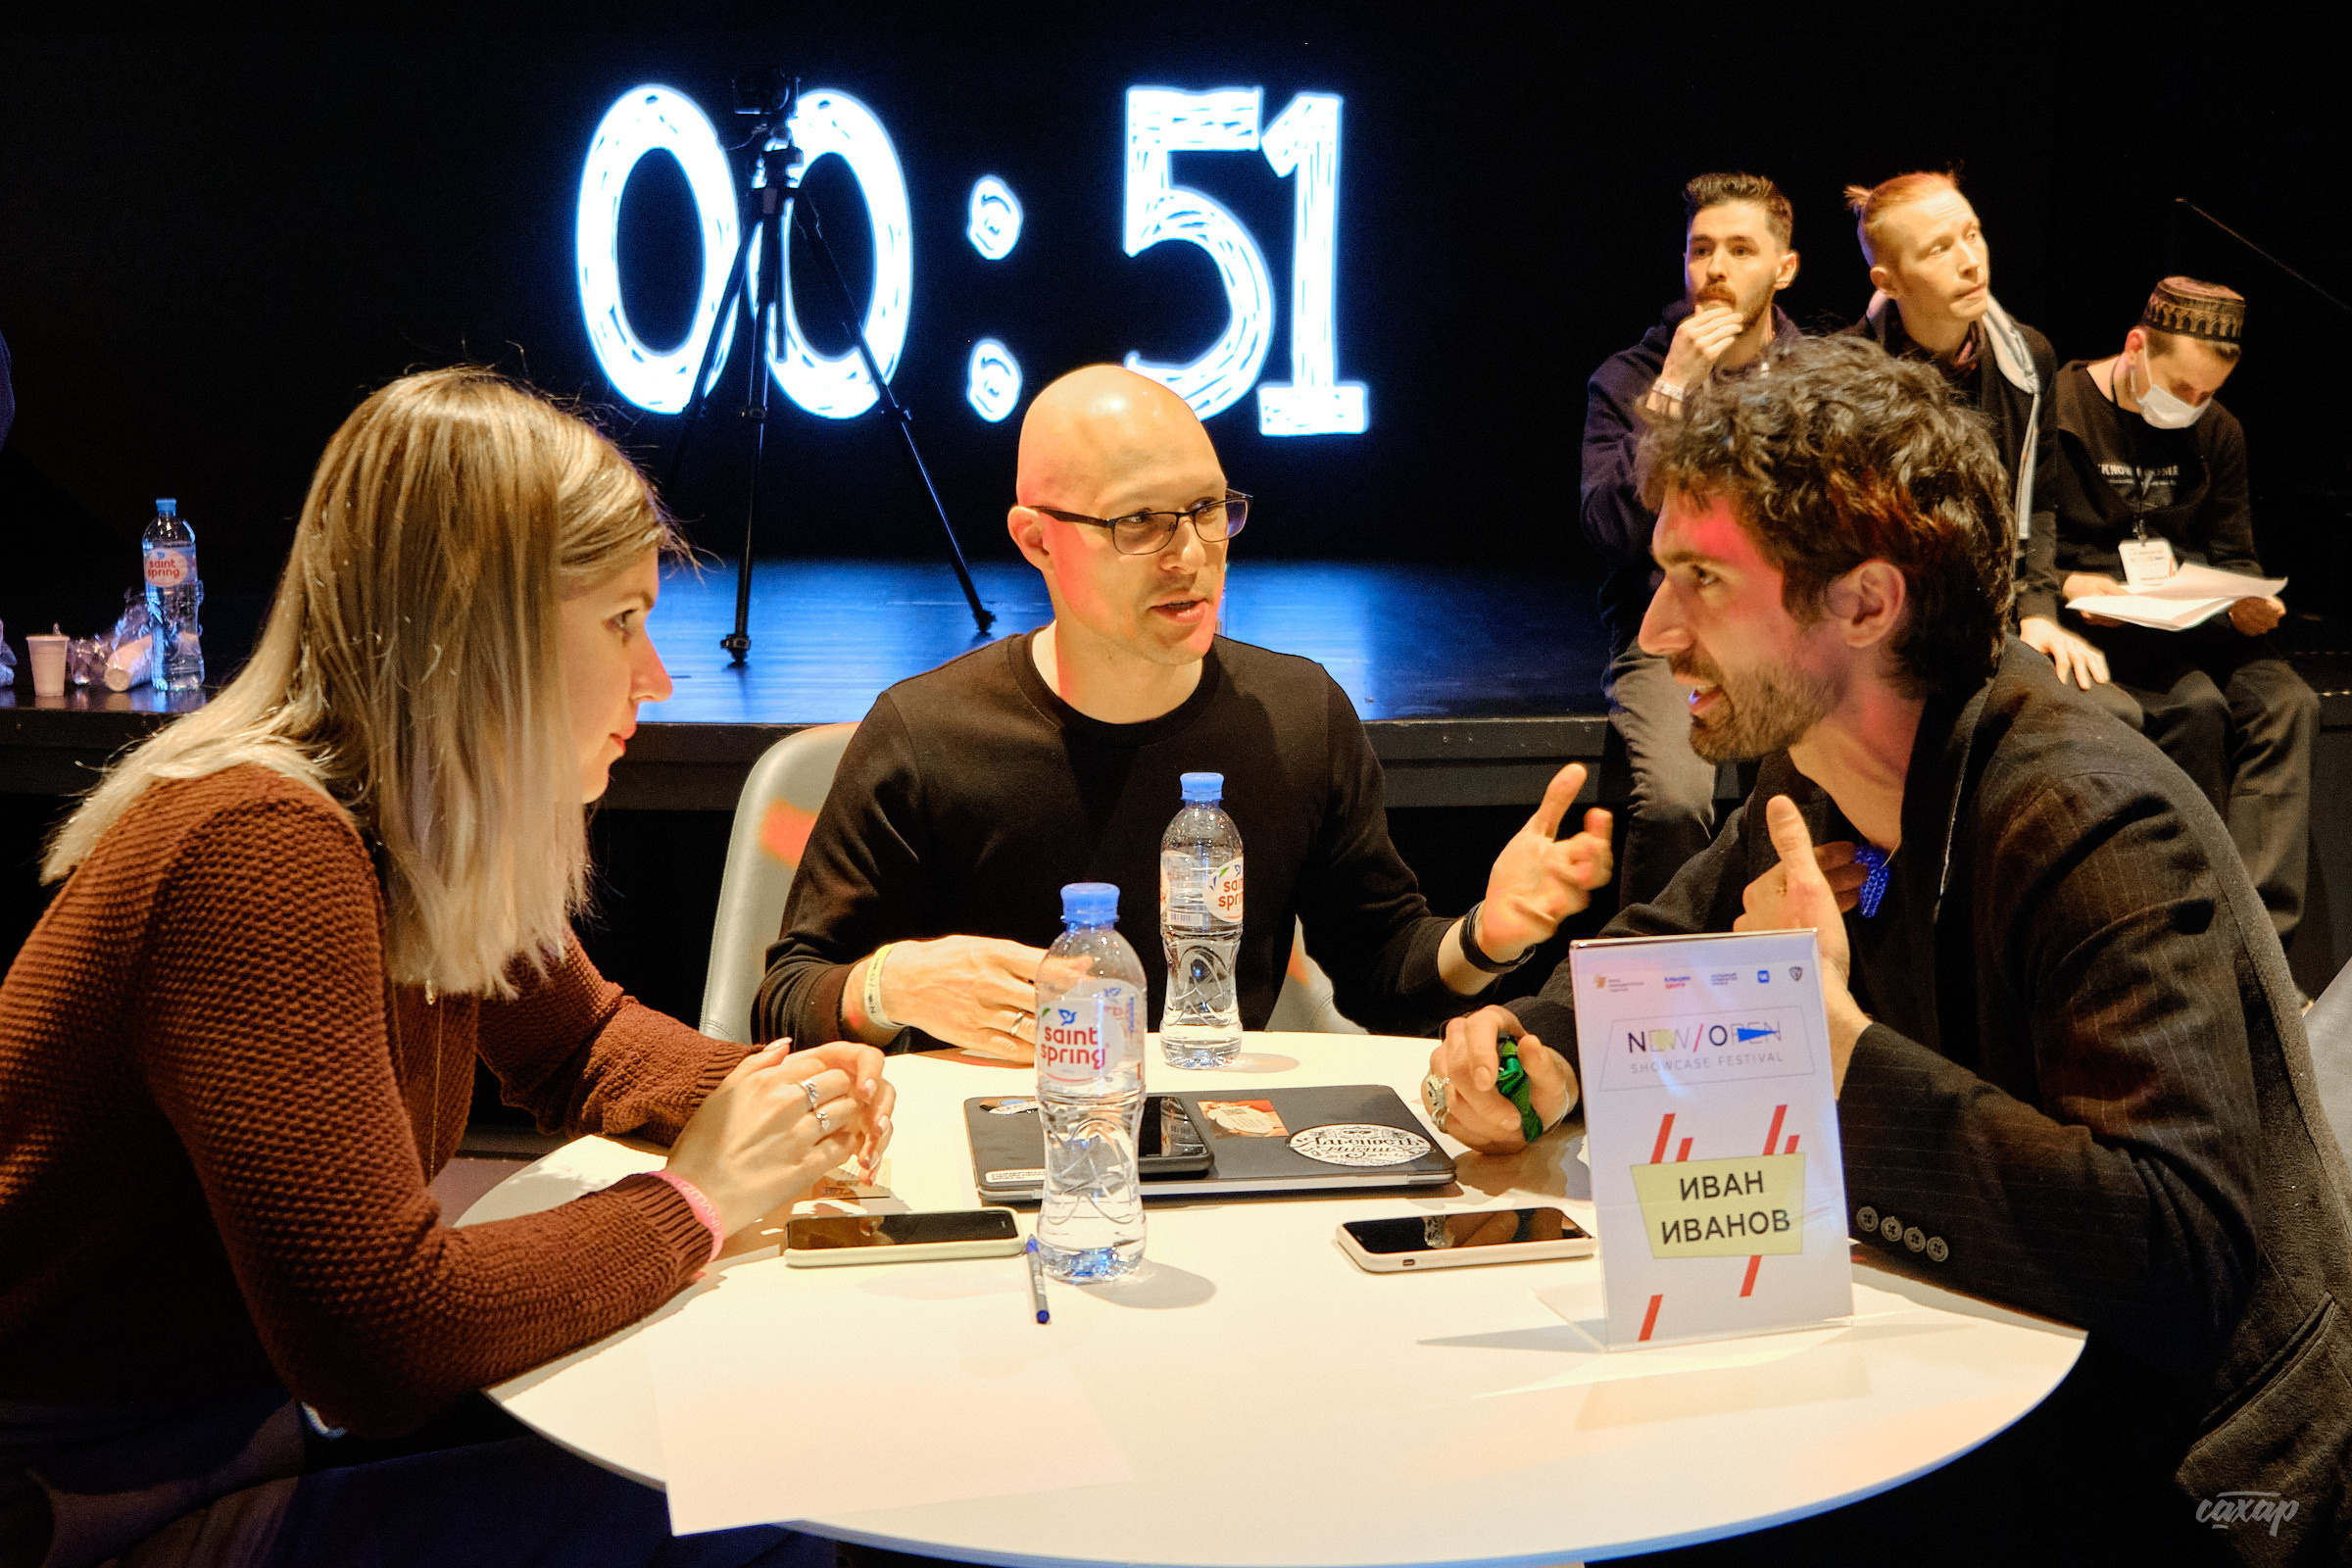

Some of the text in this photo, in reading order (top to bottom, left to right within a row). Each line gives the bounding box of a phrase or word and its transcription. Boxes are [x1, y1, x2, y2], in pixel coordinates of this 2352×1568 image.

[147, 568, 180, 579] spring
[149, 559, 175, 568] saint
[1044, 1026, 1099, 1046] saint
[1041, 1044, 1105, 1070] spring
[1630, 1052, 1784, 1074] SHOWCASE FESTIVAL
[1680, 1170, 1763, 1200] ИВАН
[1661, 1209, 1790, 1245] ИВАНОВ
